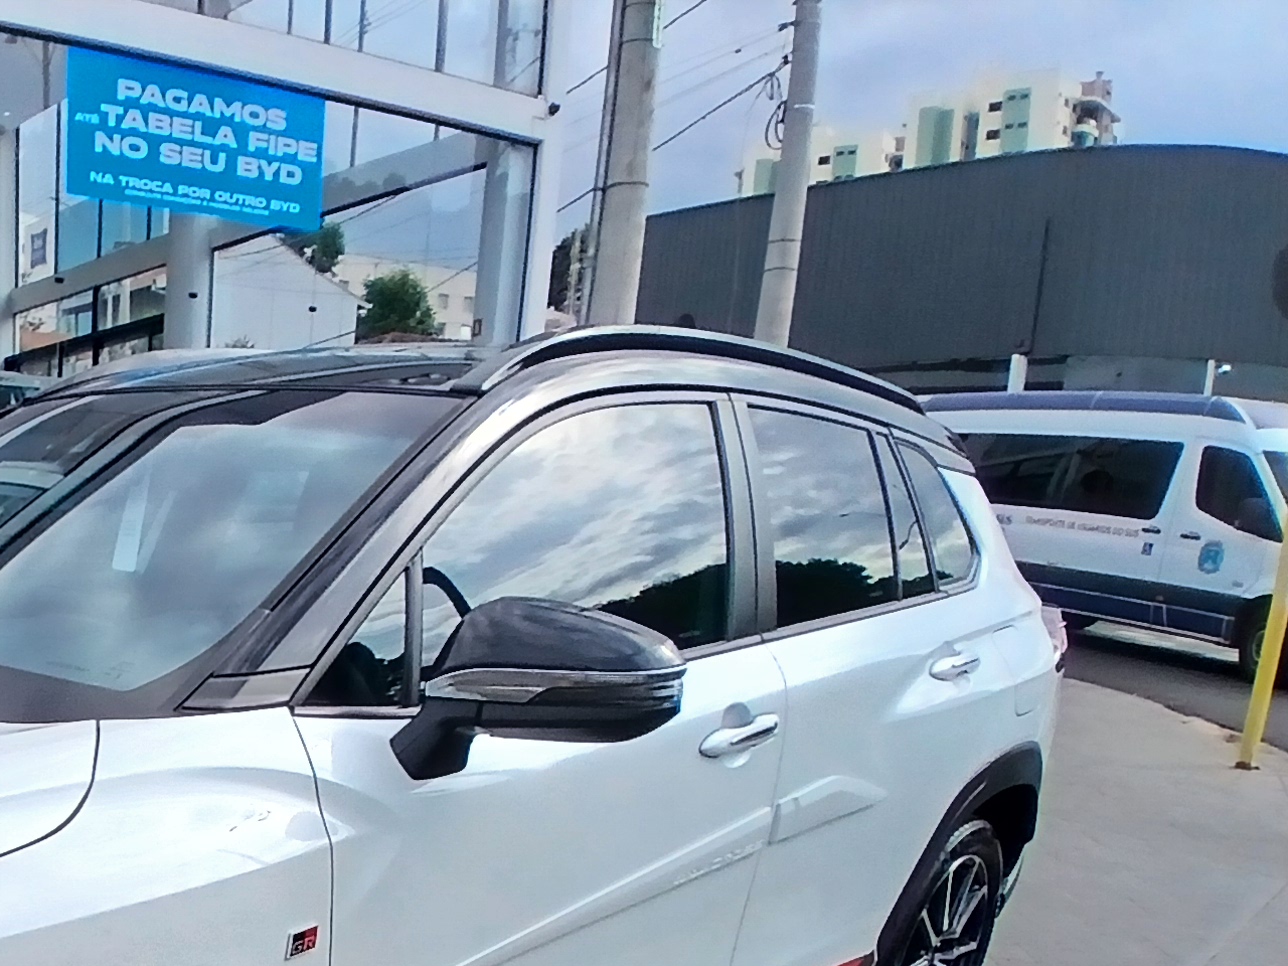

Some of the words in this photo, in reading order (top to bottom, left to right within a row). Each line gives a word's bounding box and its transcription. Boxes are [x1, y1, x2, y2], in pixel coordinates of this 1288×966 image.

[117, 78, 287, 131] PAGAMOS
[94, 131, 149, 160] NO
[159, 142, 227, 173] SEU
[236, 155, 303, 186] BYD
[100, 103, 238, 149] TABELA
[248, 131, 318, 163] FIPE
[89, 170, 115, 185] NA
[118, 174, 174, 194] TROCA
[177, 184, 211, 200] POR
[214, 190, 267, 209] OUTRO
[270, 199, 301, 214] BYD
[291, 935, 315, 955] GR
